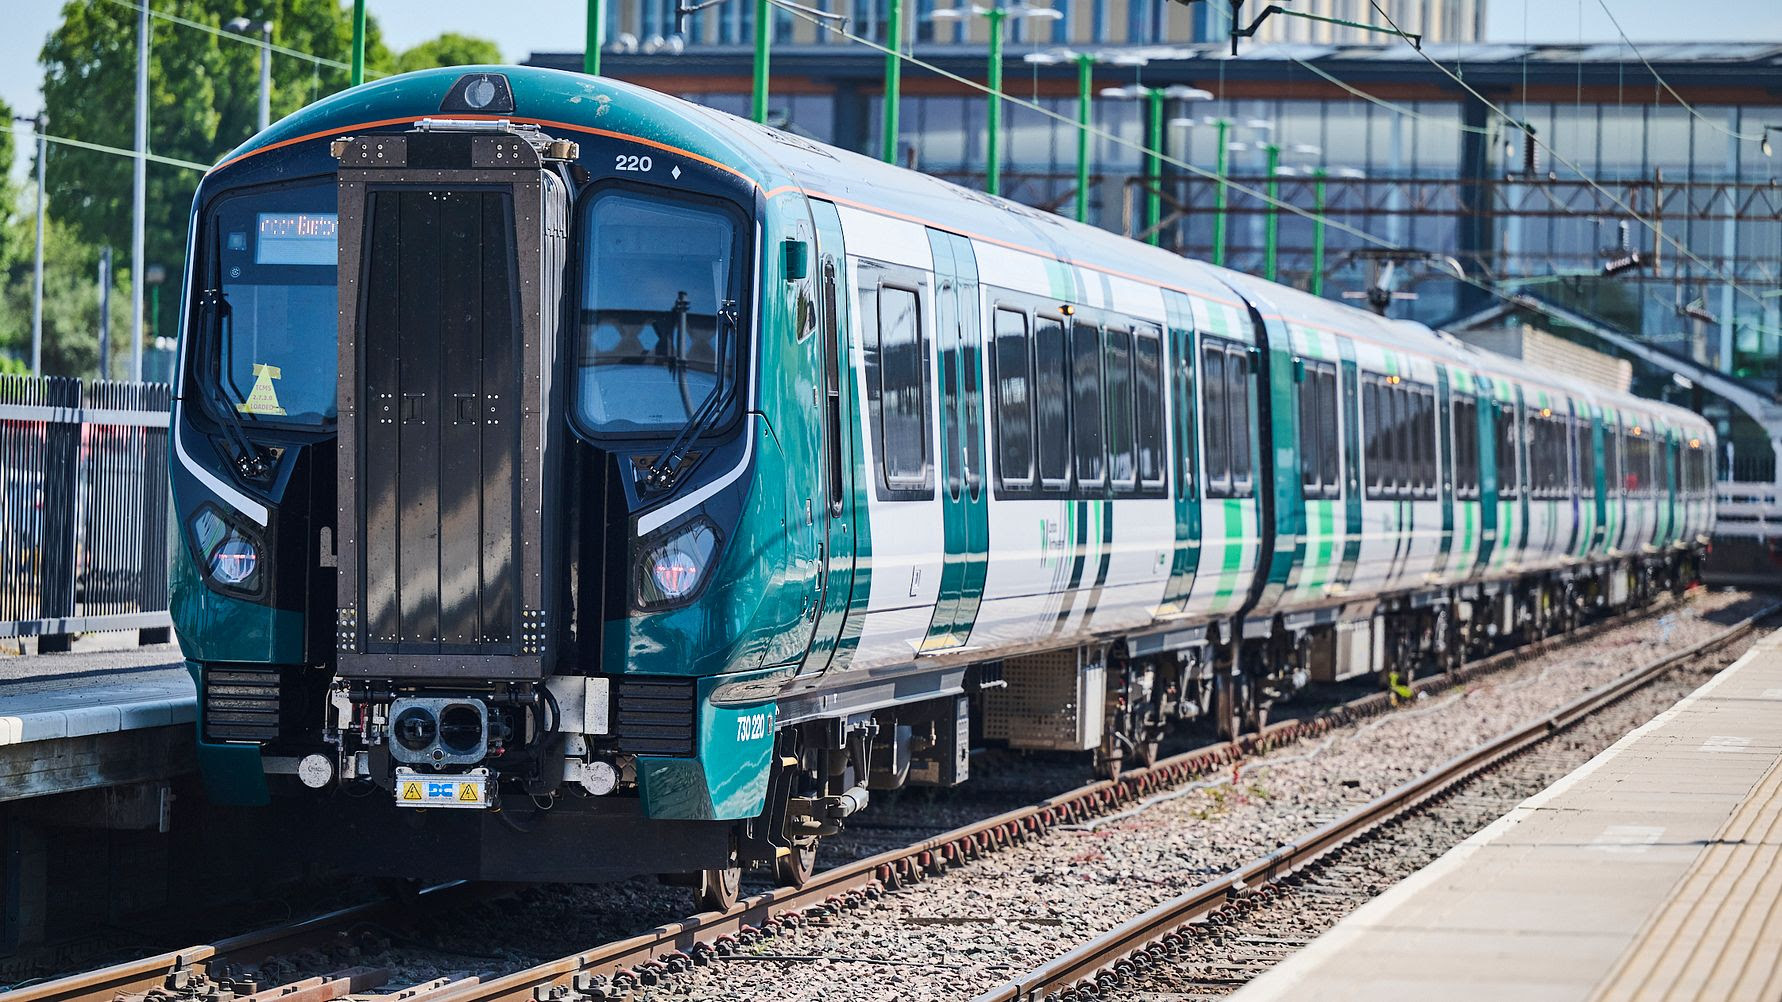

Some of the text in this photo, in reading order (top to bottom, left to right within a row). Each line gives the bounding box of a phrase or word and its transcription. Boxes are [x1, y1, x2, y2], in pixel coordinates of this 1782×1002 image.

[615, 154, 653, 172] 220
[255, 384, 272, 392] TCMS
[250, 403, 274, 411] LOADED
[736, 713, 765, 742] 730 220
